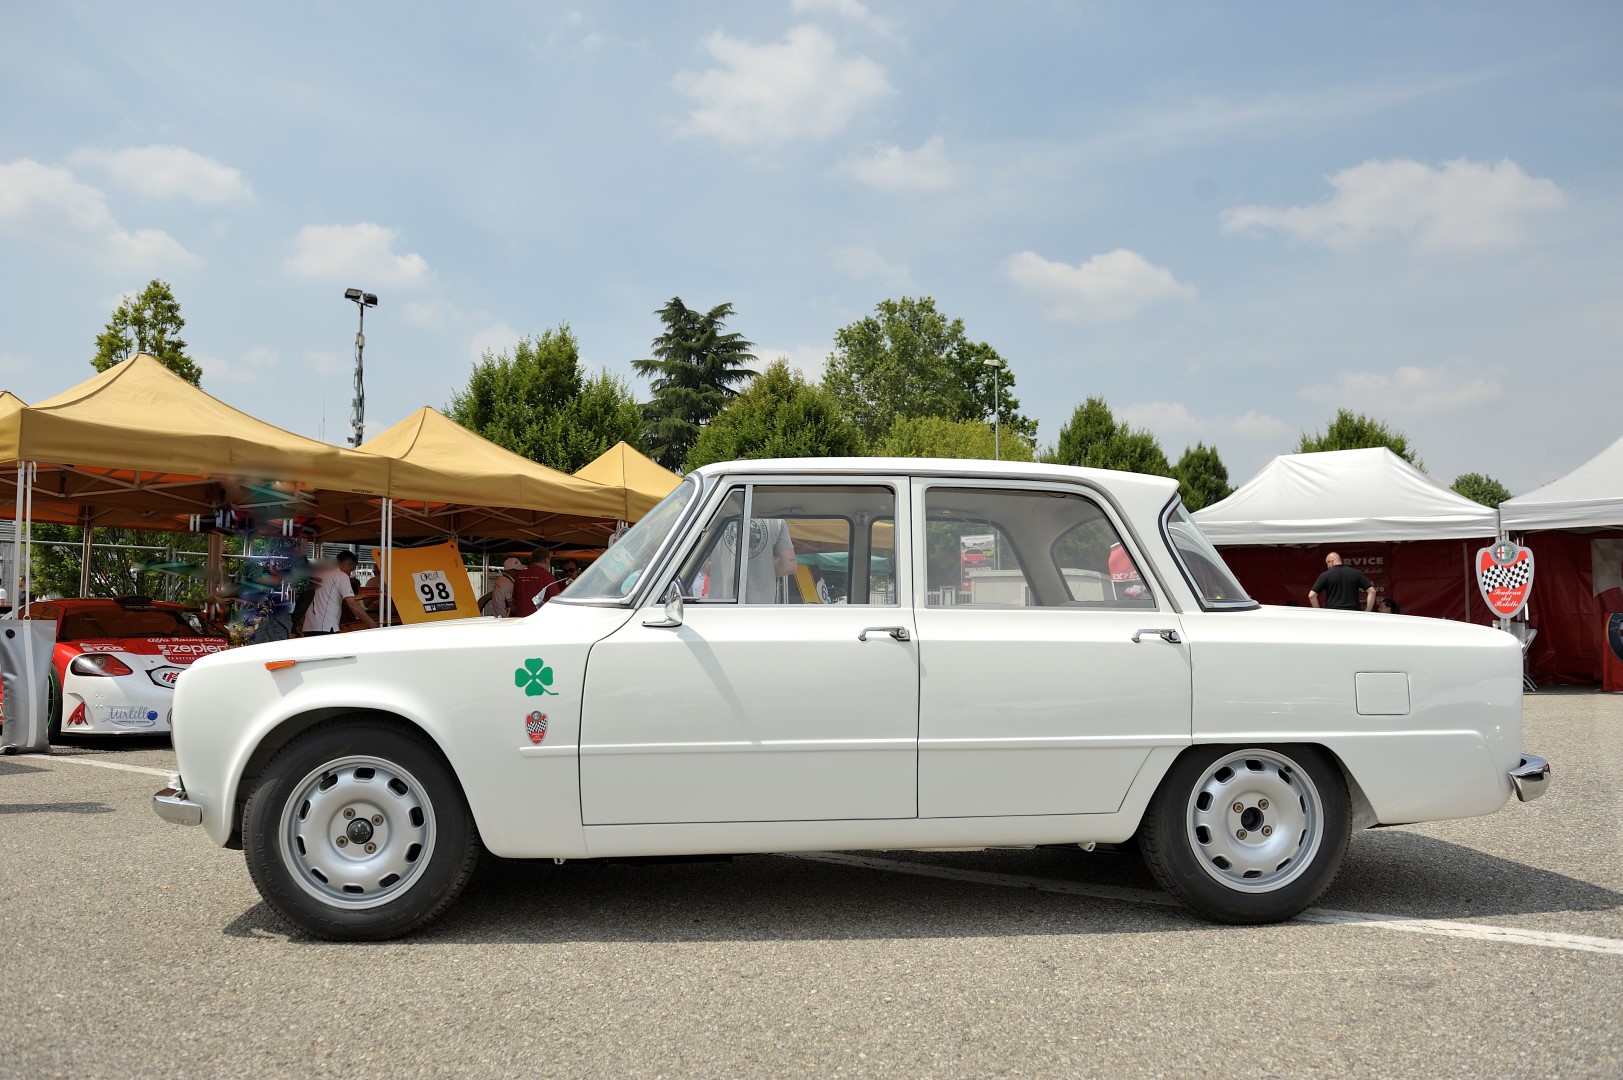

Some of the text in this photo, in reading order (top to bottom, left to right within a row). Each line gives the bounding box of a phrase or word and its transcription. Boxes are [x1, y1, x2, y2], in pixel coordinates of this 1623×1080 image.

[1343, 556, 1384, 566] RVICE
[420, 582, 450, 601] 98
[168, 642, 226, 656] zepter
